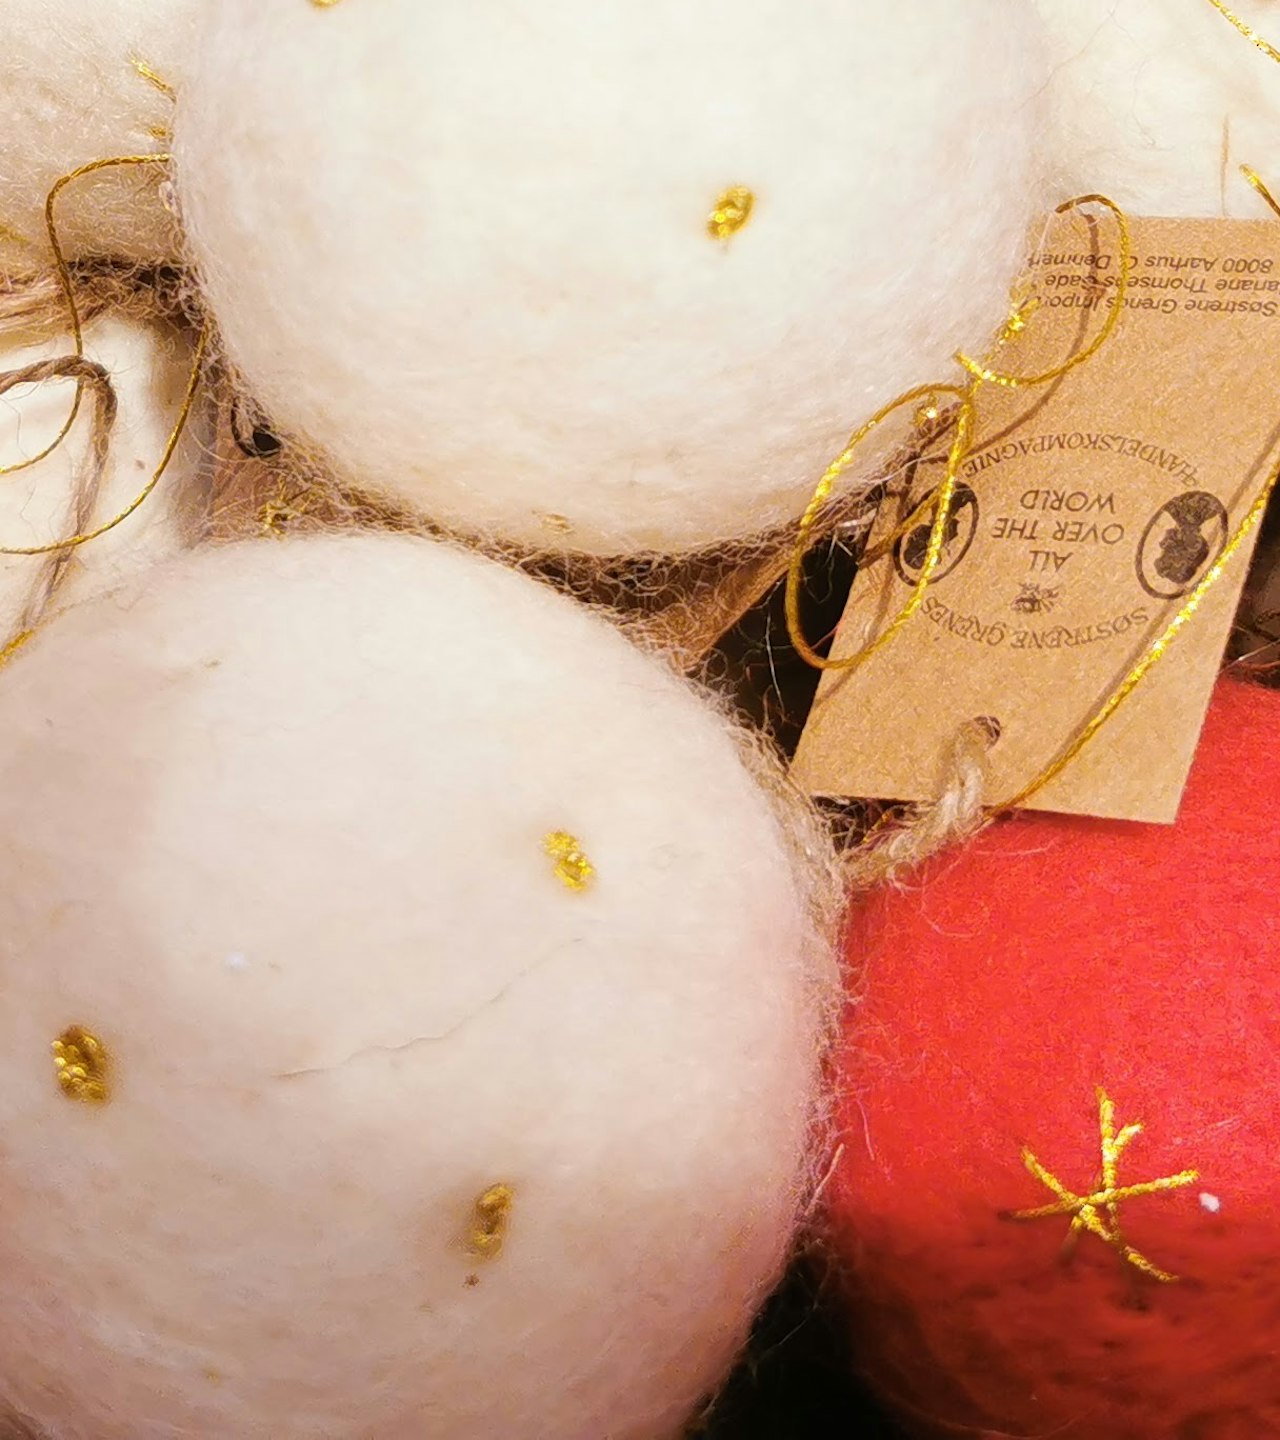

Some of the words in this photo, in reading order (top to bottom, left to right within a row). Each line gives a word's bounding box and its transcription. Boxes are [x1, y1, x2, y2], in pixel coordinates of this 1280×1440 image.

[1144, 256, 1218, 272] Aarhus
[1222, 258, 1274, 274] 8000
[1184, 299, 1278, 318] Søstrene
[961, 433, 1199, 488] HANDELSKOMPAGNIE
[1019, 490, 1116, 516] WORLD
[990, 517, 1037, 540] THE
[1049, 522, 1125, 546] OVER
[1028, 549, 1073, 573] ALL
[917, 595, 1006, 648] GRENES
[1009, 607, 1150, 649] SØSTRENE
